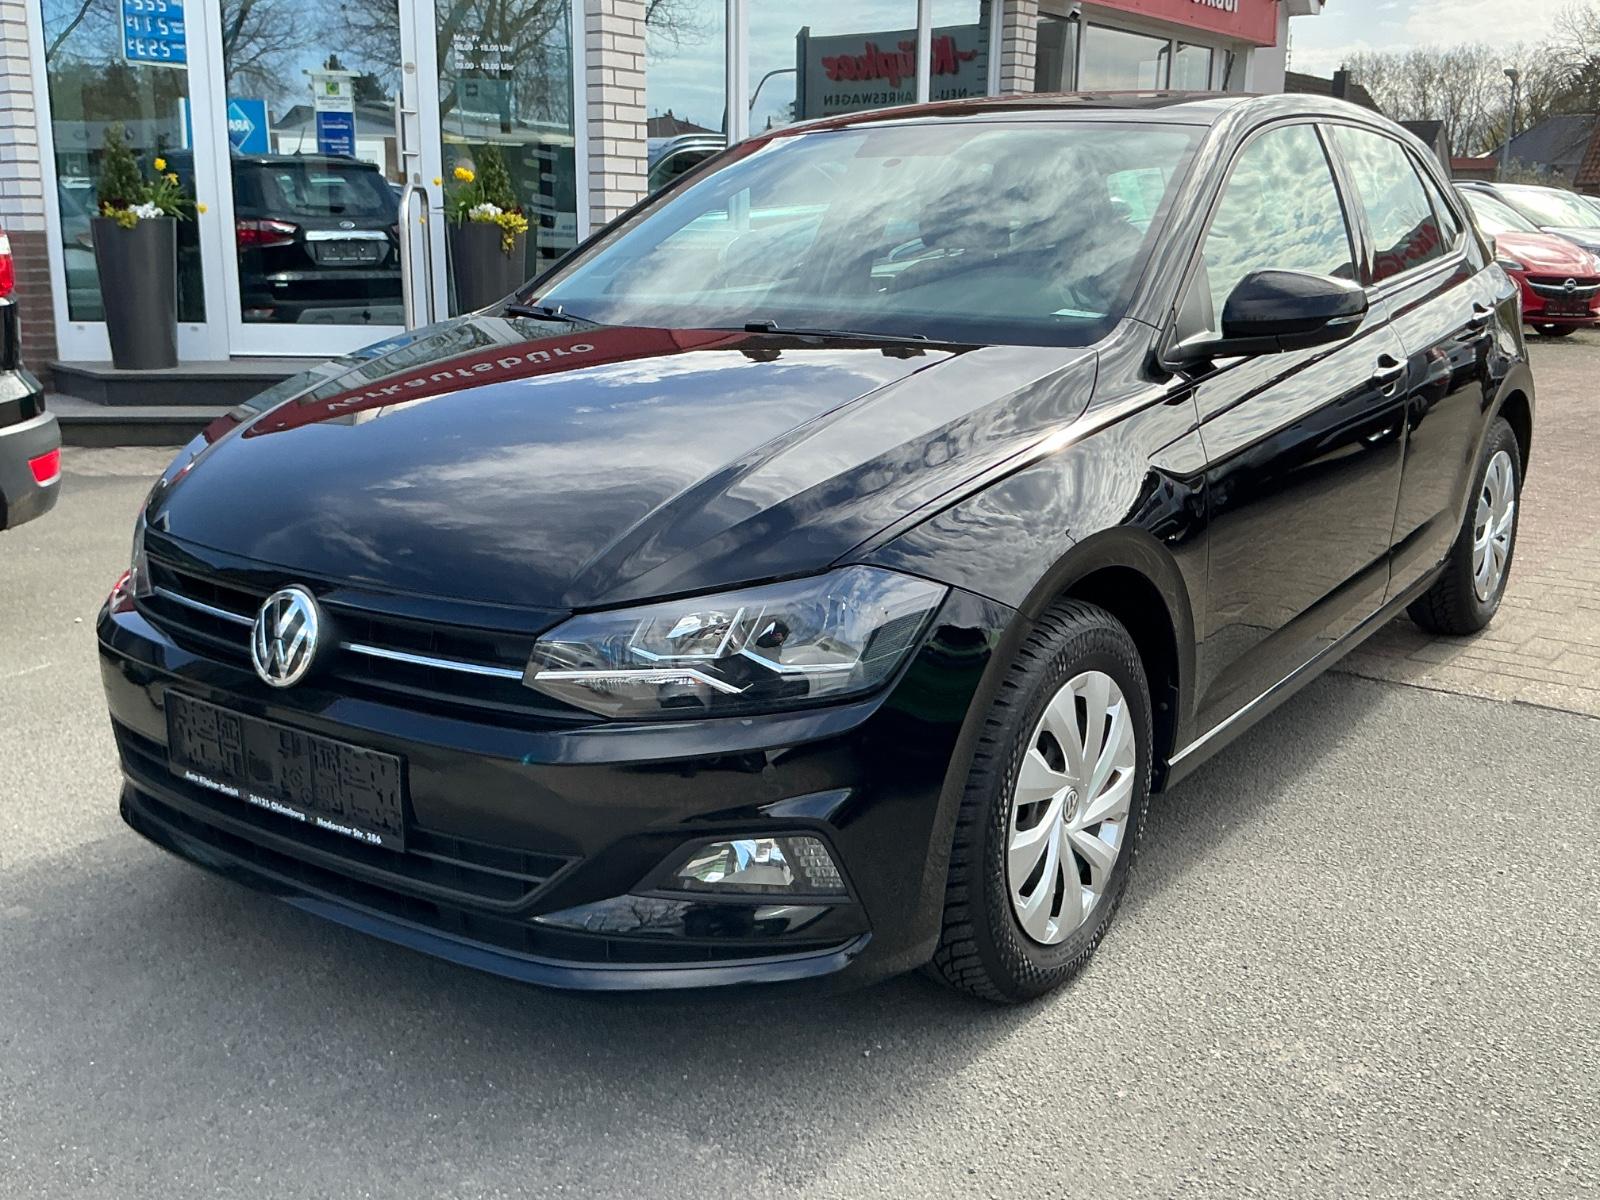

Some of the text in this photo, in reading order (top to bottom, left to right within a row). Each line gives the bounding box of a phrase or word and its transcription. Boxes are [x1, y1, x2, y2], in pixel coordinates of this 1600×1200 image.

[500, 44, 514, 52] Uhr
[501, 63, 515, 71] Uhr
[251, 588, 318, 688] VW
[270, 801, 306, 821] Oldenburg
